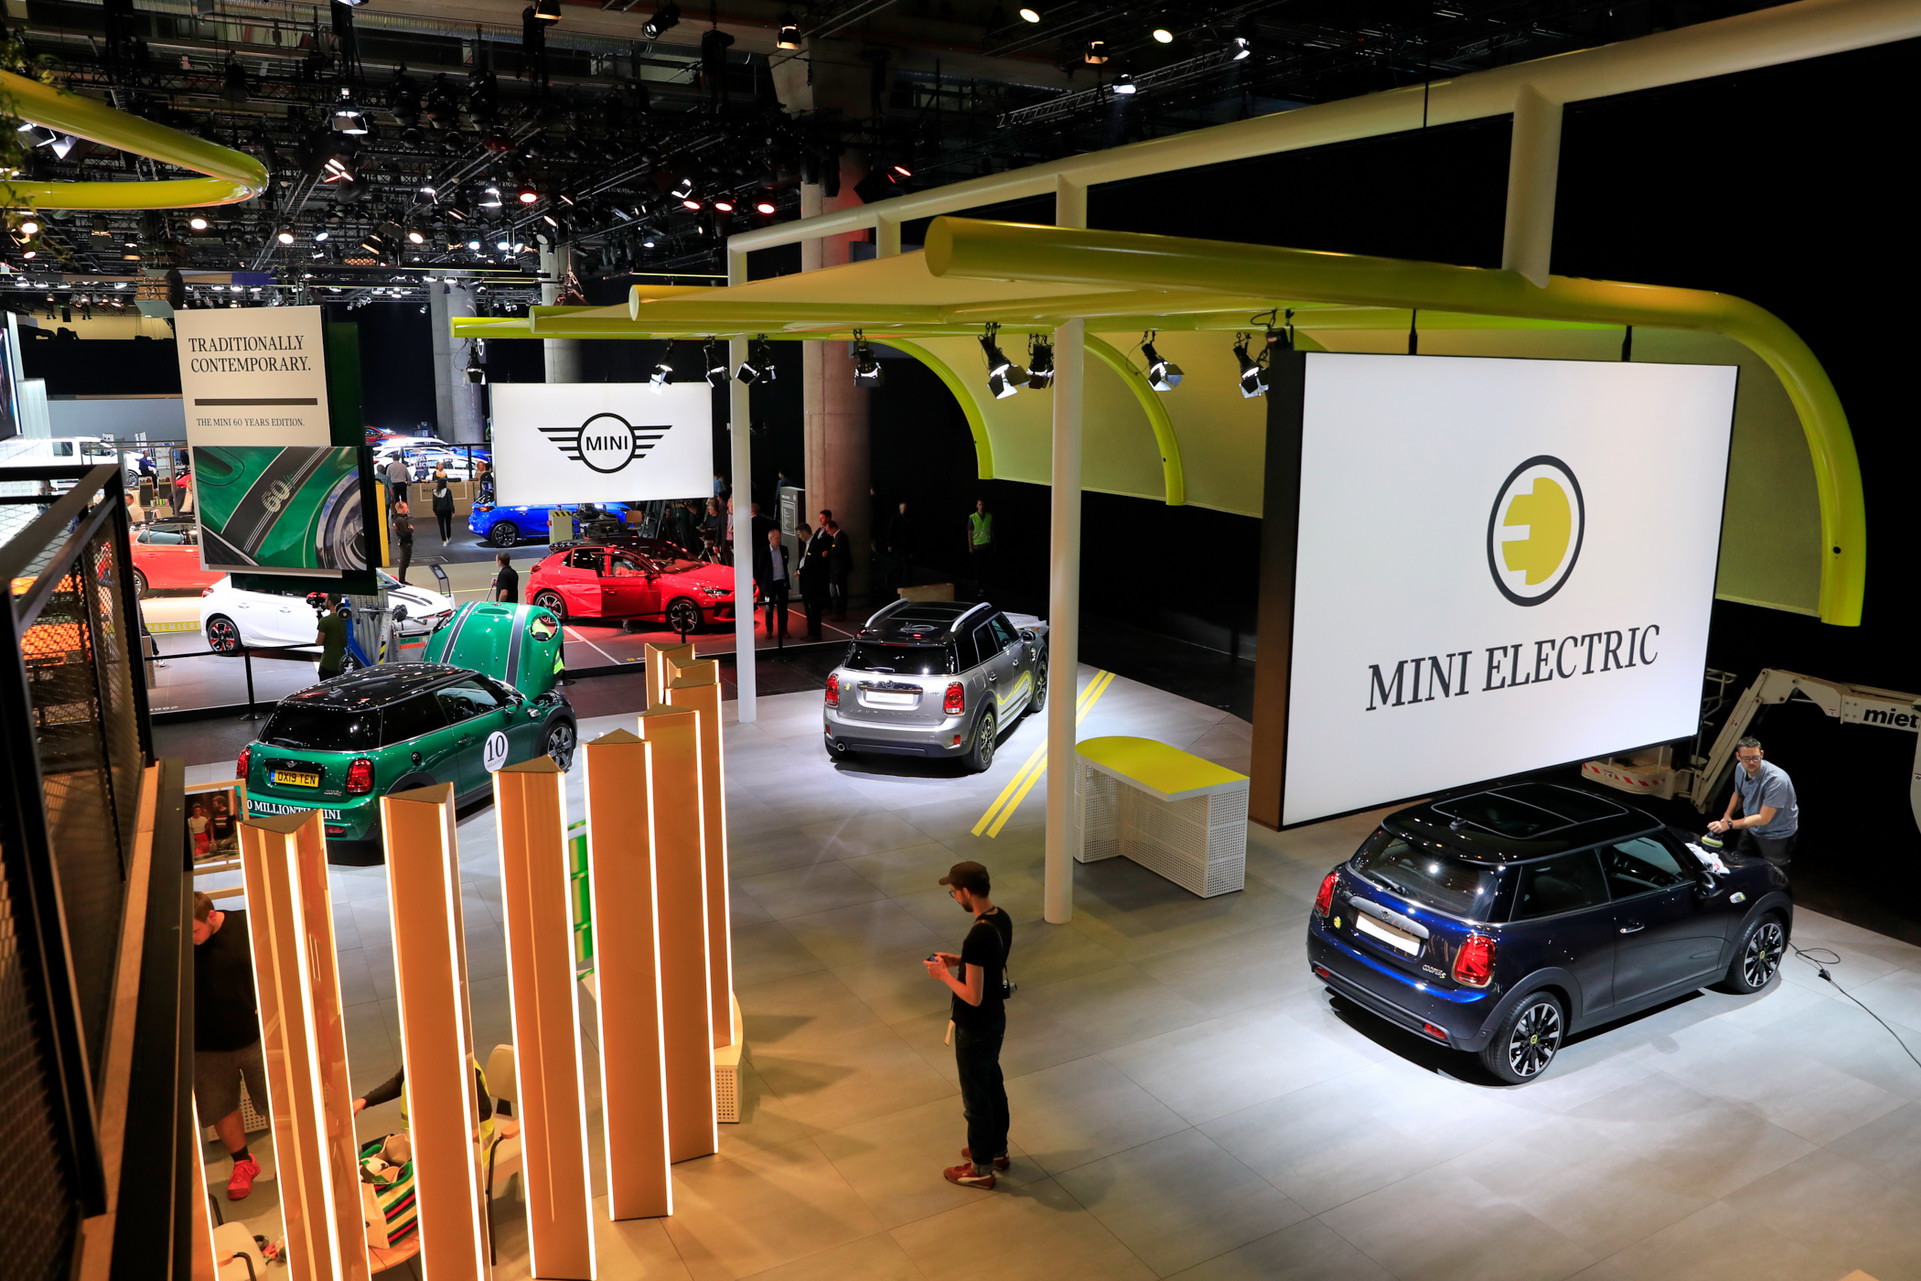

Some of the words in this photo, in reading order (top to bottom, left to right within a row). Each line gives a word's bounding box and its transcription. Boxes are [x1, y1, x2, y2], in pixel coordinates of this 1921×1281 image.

[188, 335, 304, 352] TRADITIONALLY
[191, 356, 311, 373] CONTEMPORARY.
[196, 418, 212, 427] THE
[213, 418, 231, 427] MINI
[233, 418, 243, 427] 60
[244, 418, 270, 427] YEARS
[271, 418, 305, 427] EDITION.
[586, 435, 628, 451] MINI
[1366, 651, 1472, 711] MINI
[1482, 624, 1660, 692] ELECTRIC
[487, 734, 505, 762] 10
[278, 771, 297, 783] OX19
[300, 773, 316, 785] TEN
